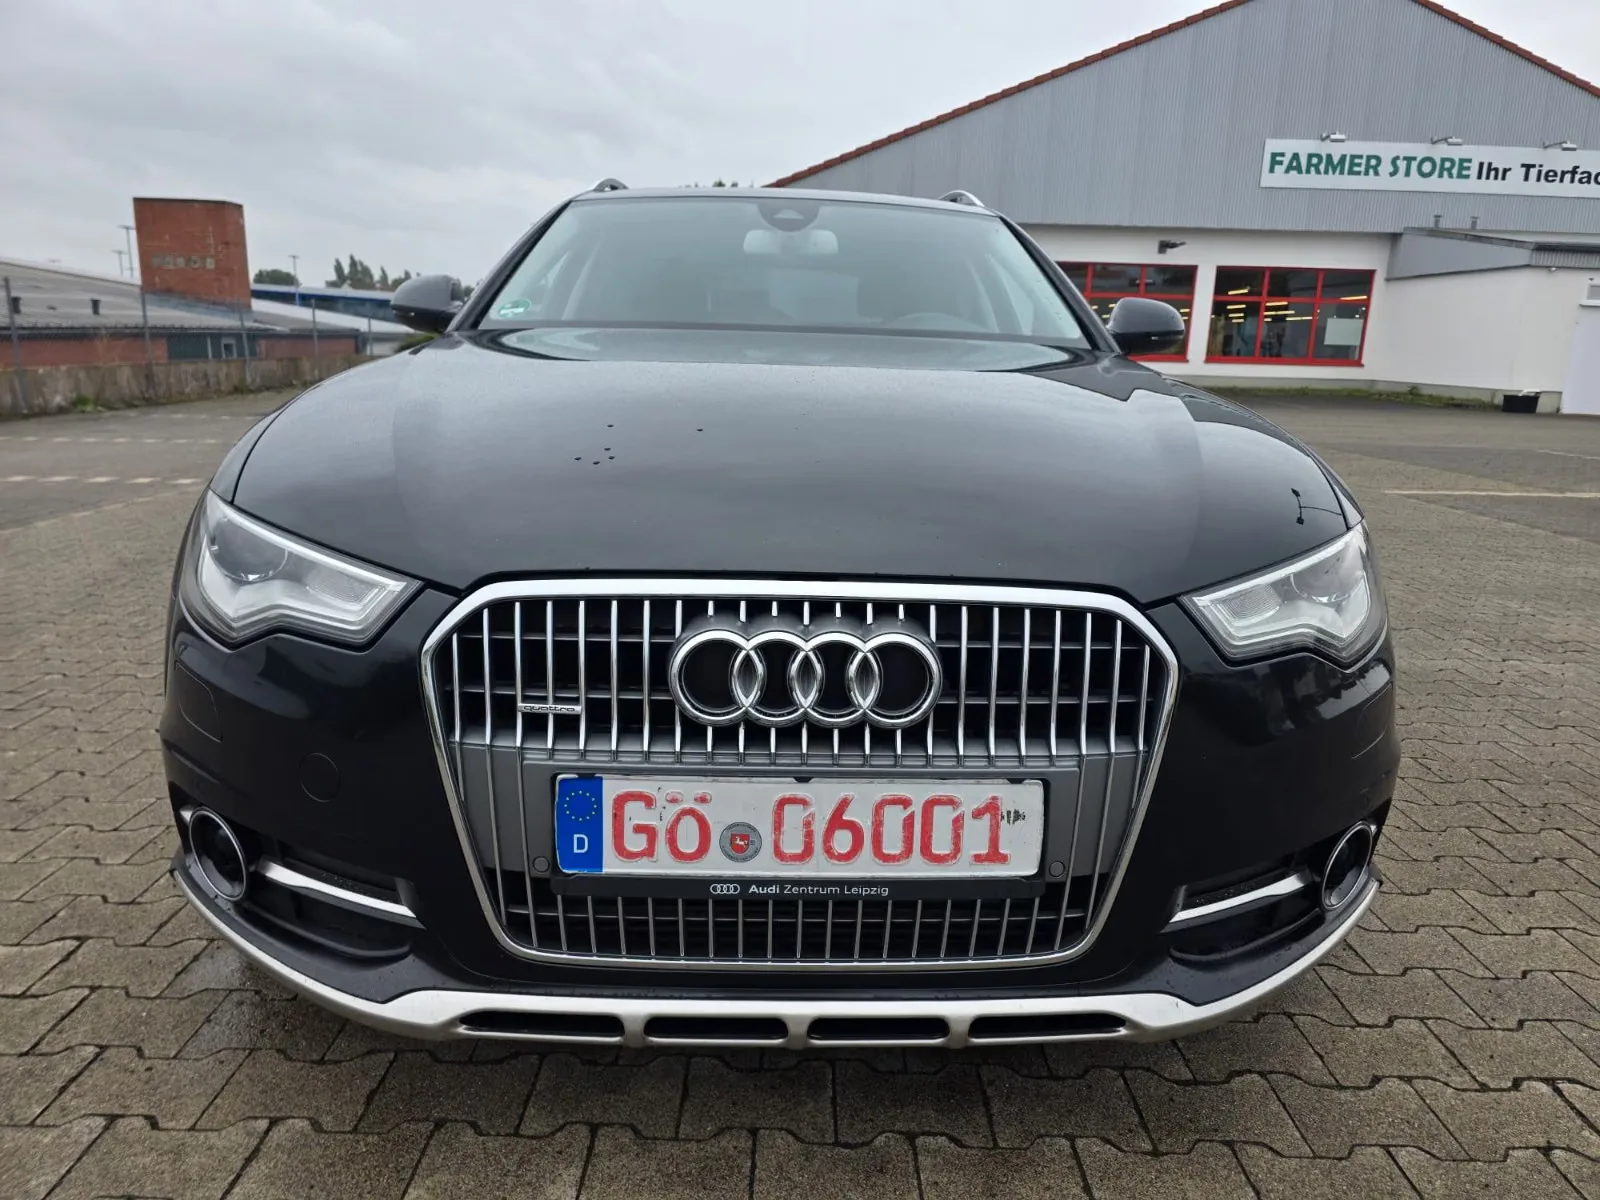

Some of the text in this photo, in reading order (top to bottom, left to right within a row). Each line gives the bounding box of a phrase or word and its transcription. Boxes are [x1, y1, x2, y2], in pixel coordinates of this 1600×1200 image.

[1268, 152, 1382, 177] FARMER
[1388, 155, 1473, 180] STORE
[1476, 161, 1512, 181] Ihr
[612, 790, 713, 863] GÖ
[771, 793, 1011, 866] 06001
[573, 833, 589, 853] D
[748, 884, 889, 896] Audi Zentrum Leipzig
